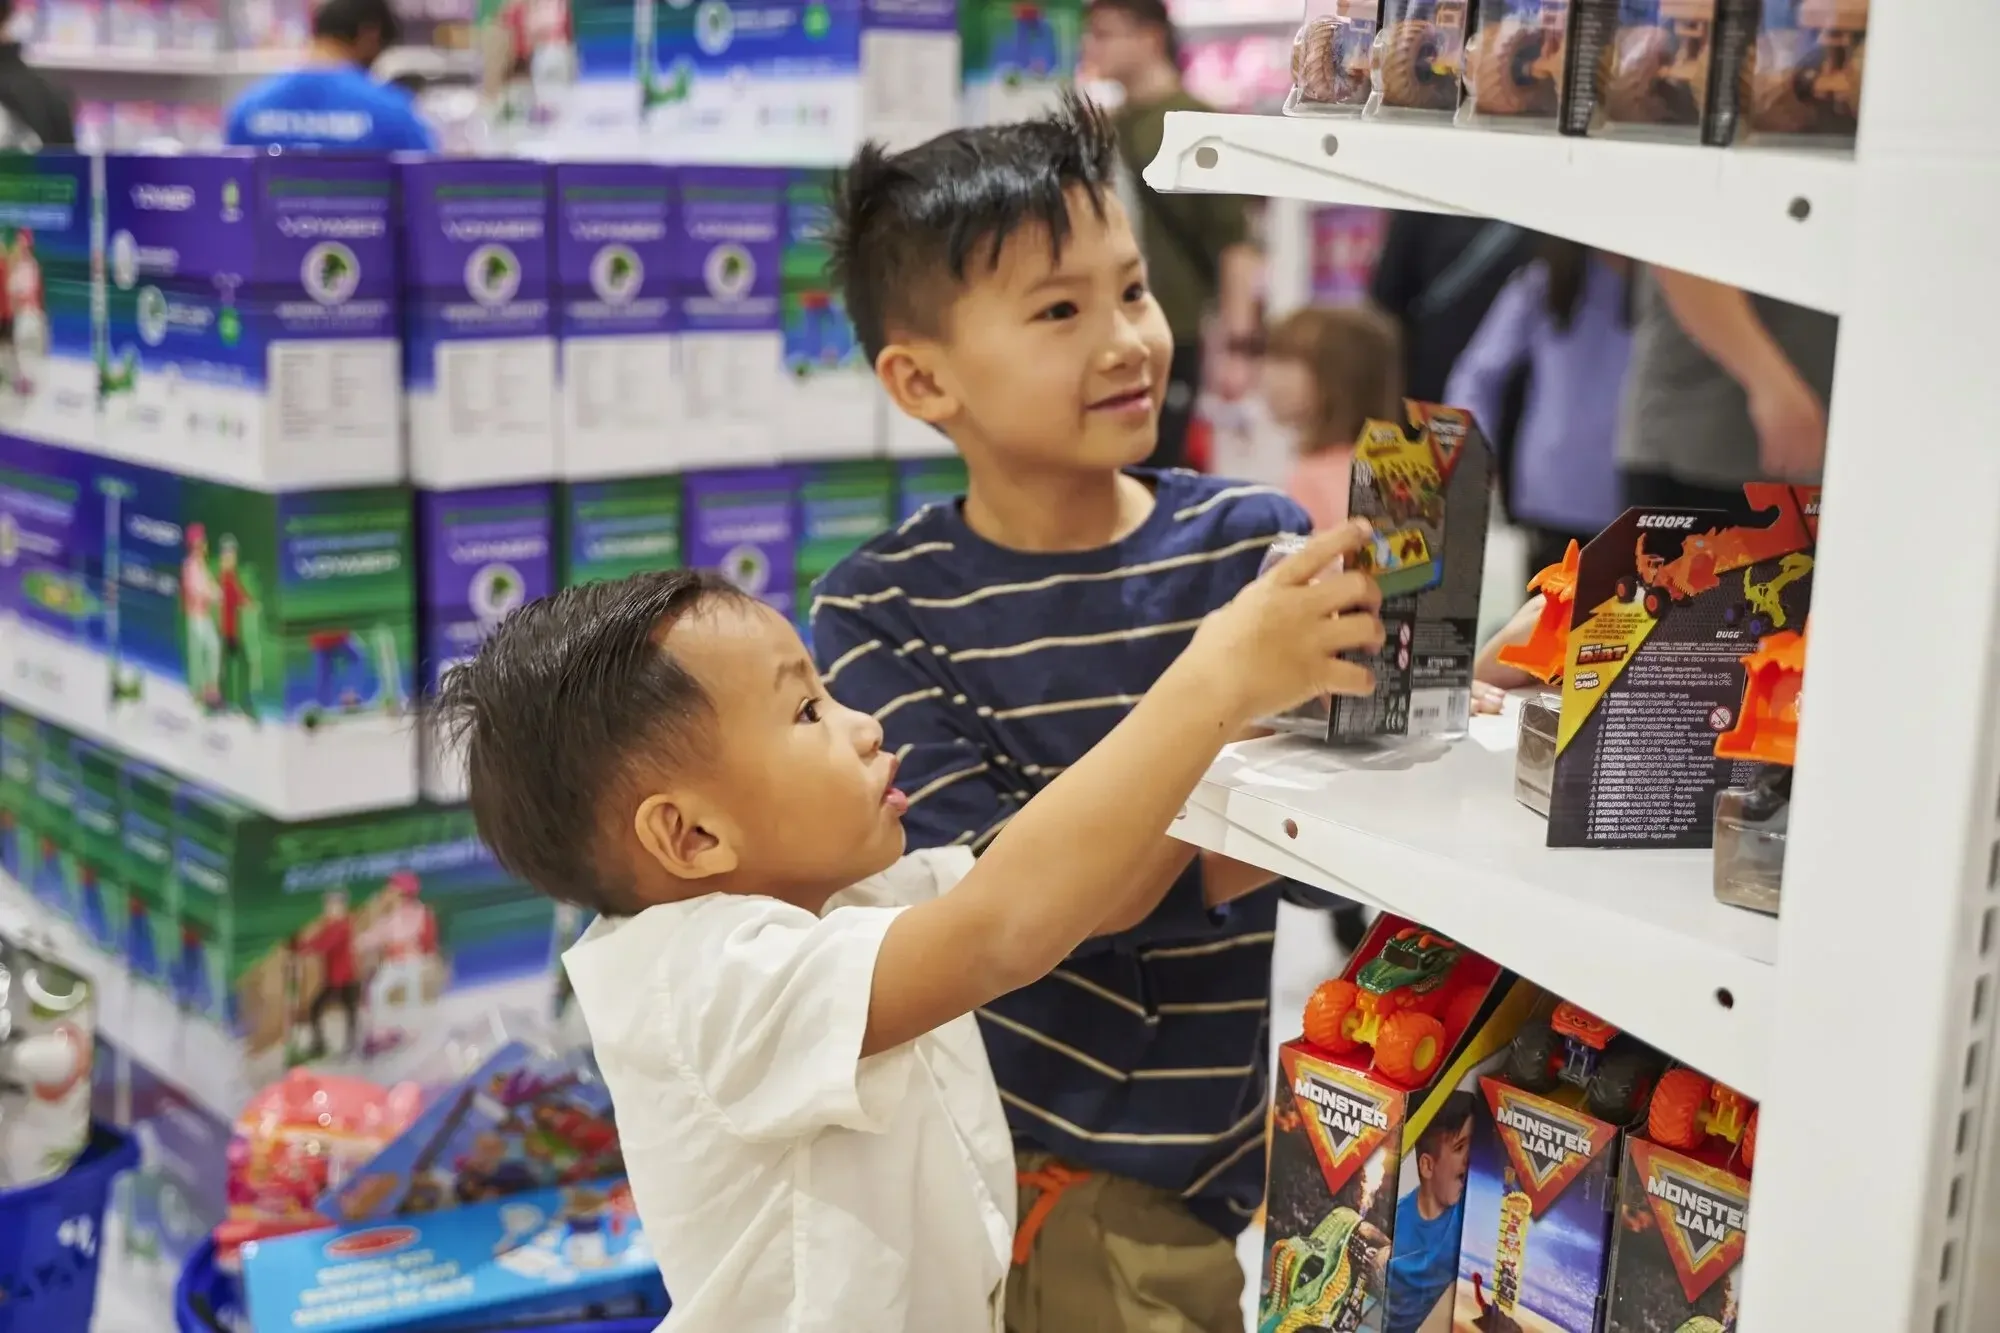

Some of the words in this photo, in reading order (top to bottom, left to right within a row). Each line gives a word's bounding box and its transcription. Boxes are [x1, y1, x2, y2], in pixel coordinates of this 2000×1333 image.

[1636, 515, 1694, 528] SCOOPZ
[1716, 631, 1740, 639] DUGG
[1295, 1078, 1387, 1130] MONSTER
[1319, 1107, 1360, 1137] JAM
[1497, 1106, 1592, 1157] MONSTER
[1521, 1135, 1564, 1162] JAM
[1675, 1209, 1725, 1241] JAM
